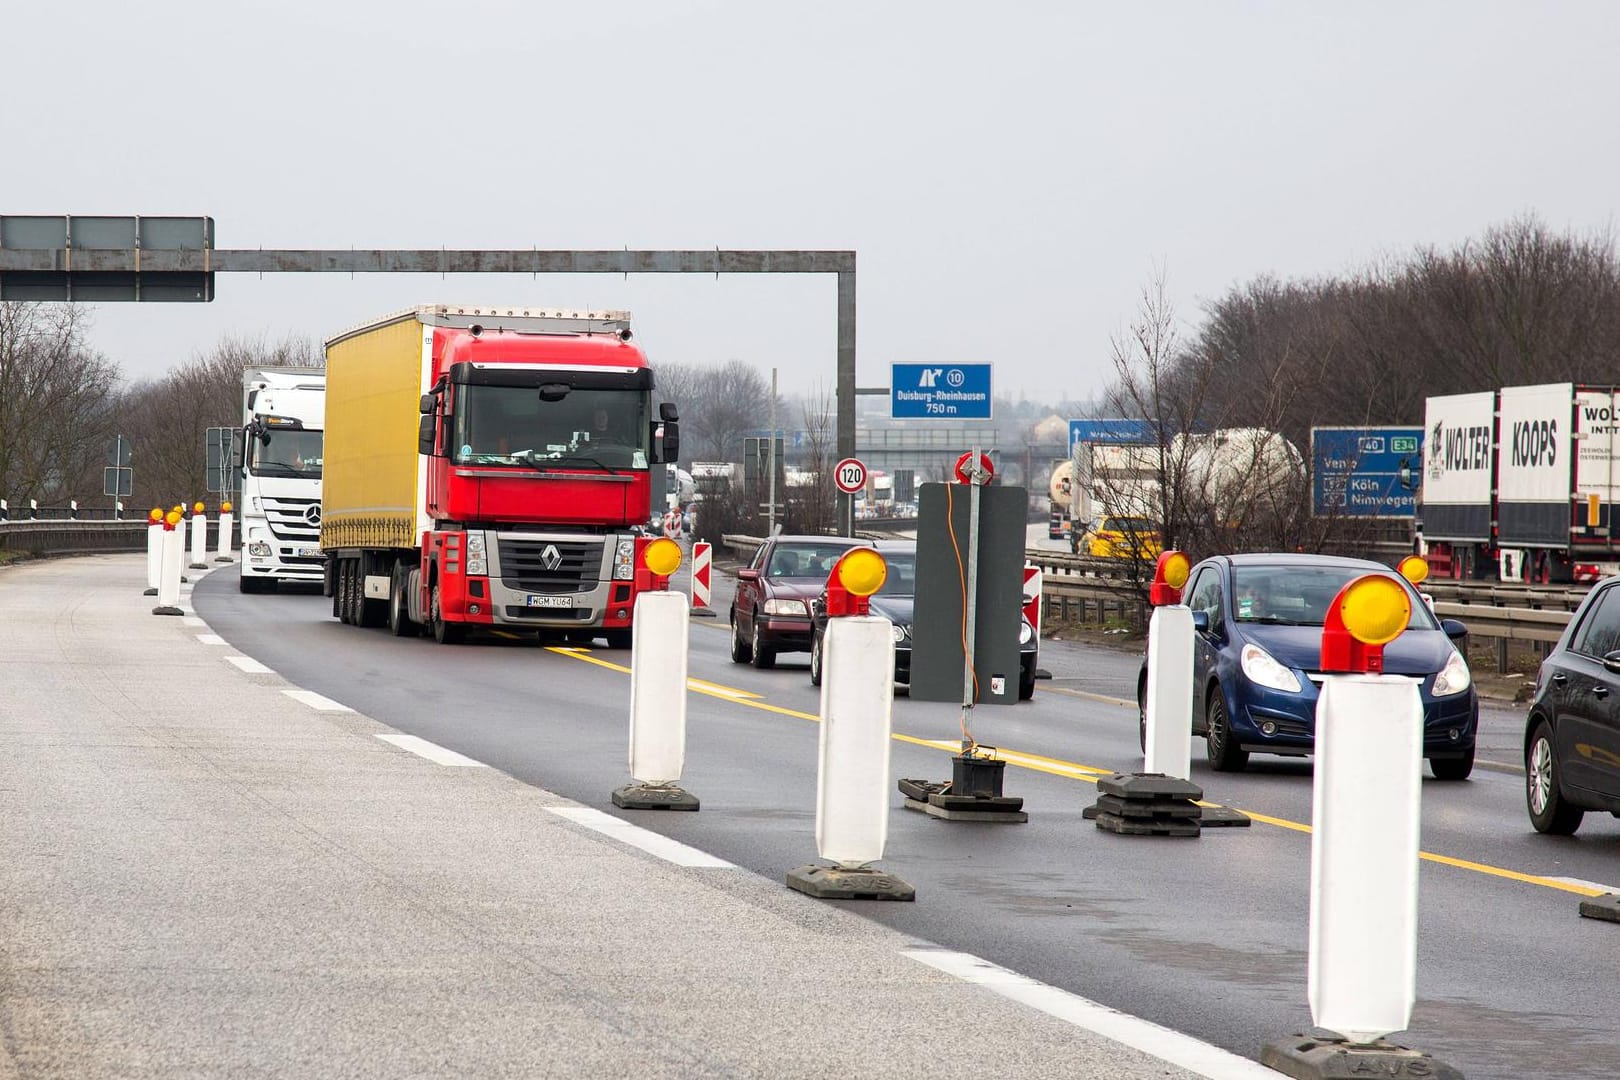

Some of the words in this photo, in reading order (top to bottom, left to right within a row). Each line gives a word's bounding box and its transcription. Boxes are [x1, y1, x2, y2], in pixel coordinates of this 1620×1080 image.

[950, 373, 961, 383] 10
[897, 390, 986, 402] Duisburg-Rheinhausen
[926, 403, 944, 413] 750
[1365, 440, 1378, 450] 40
[1394, 440, 1414, 450] E34
[1446, 426, 1490, 471] WOLTER
[1512, 419, 1557, 467] KOOPS
[842, 469, 860, 483] 120
[1352, 478, 1379, 490] Köln
[1352, 494, 1416, 508] Nimwegen
